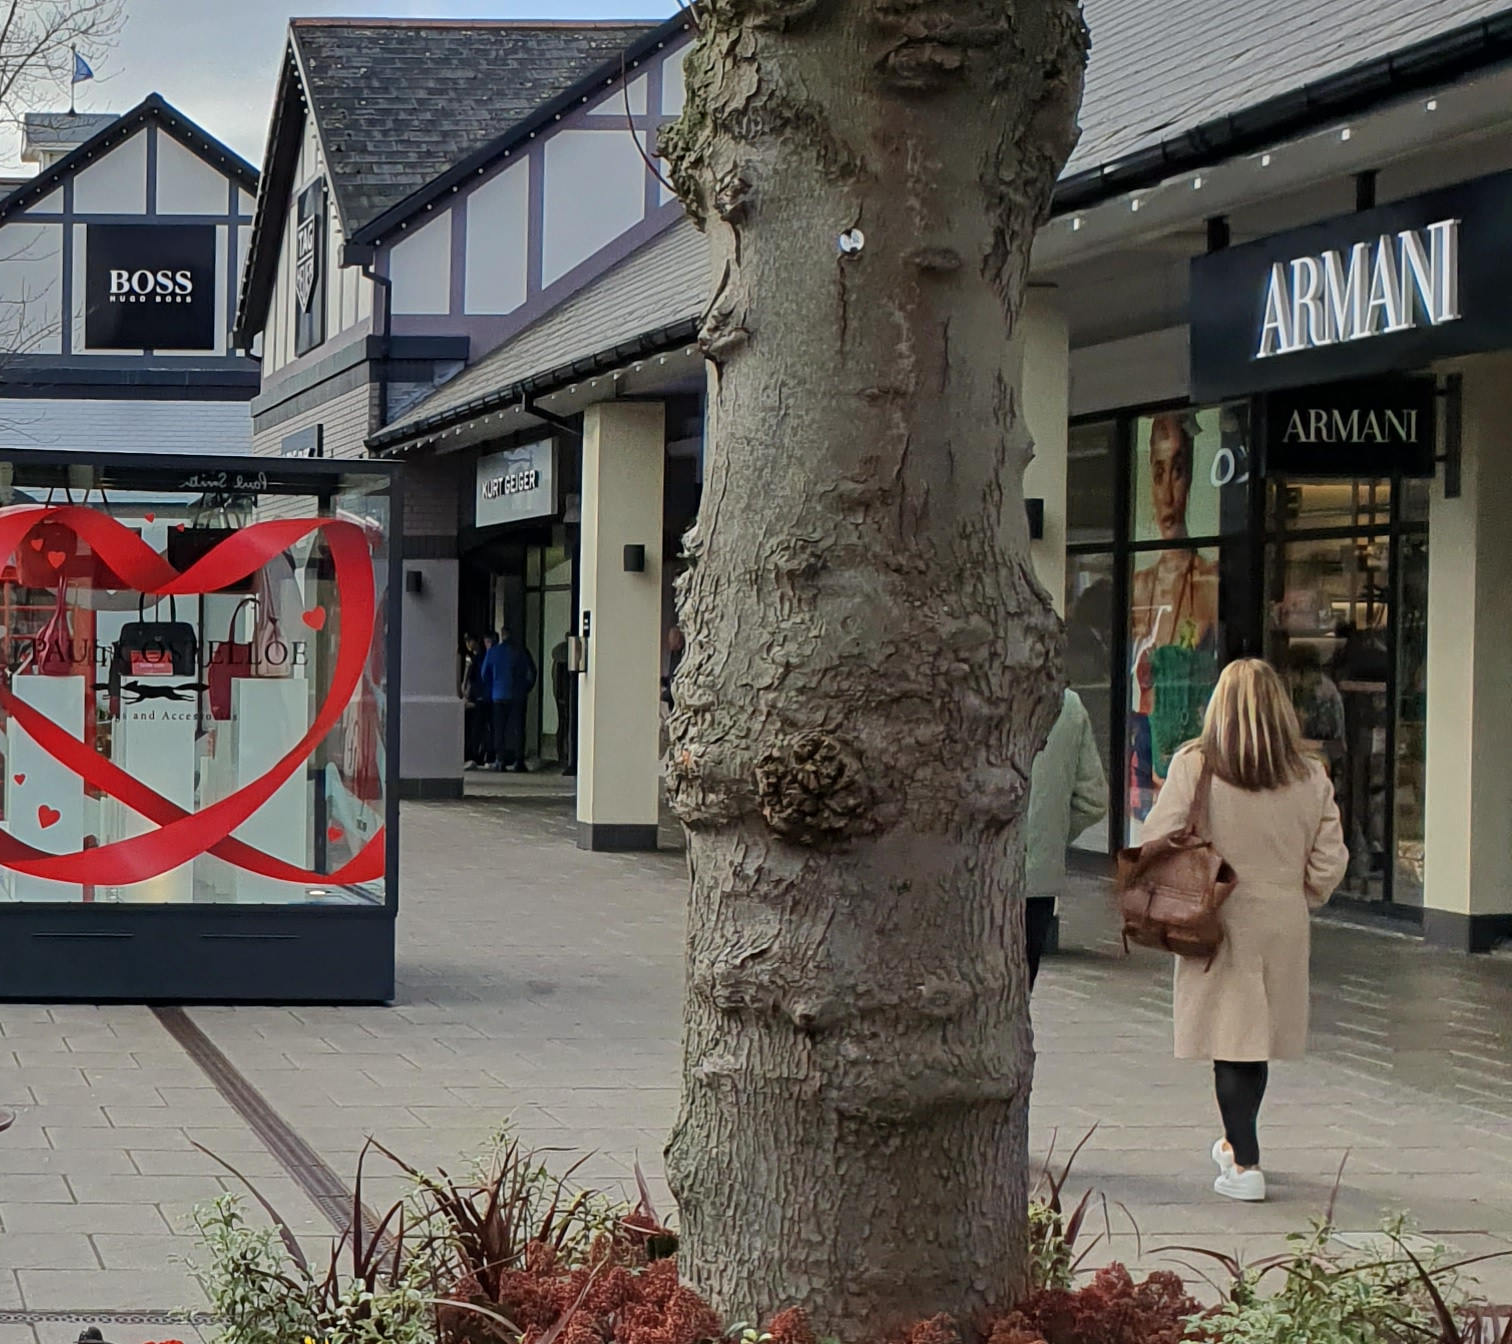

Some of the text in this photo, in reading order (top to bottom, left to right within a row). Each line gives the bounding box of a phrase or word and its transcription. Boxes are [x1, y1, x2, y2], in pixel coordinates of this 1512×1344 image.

[298, 223, 314, 258] TAG
[109, 269, 193, 294] BOSS
[1255, 218, 1462, 359] ARMANI
[1281, 408, 1418, 444] ARMANI
[482, 469, 537, 499] KURT GEIGER
[31, 638, 308, 666] PAUL COSELLOE
[133, 710, 155, 721] and
